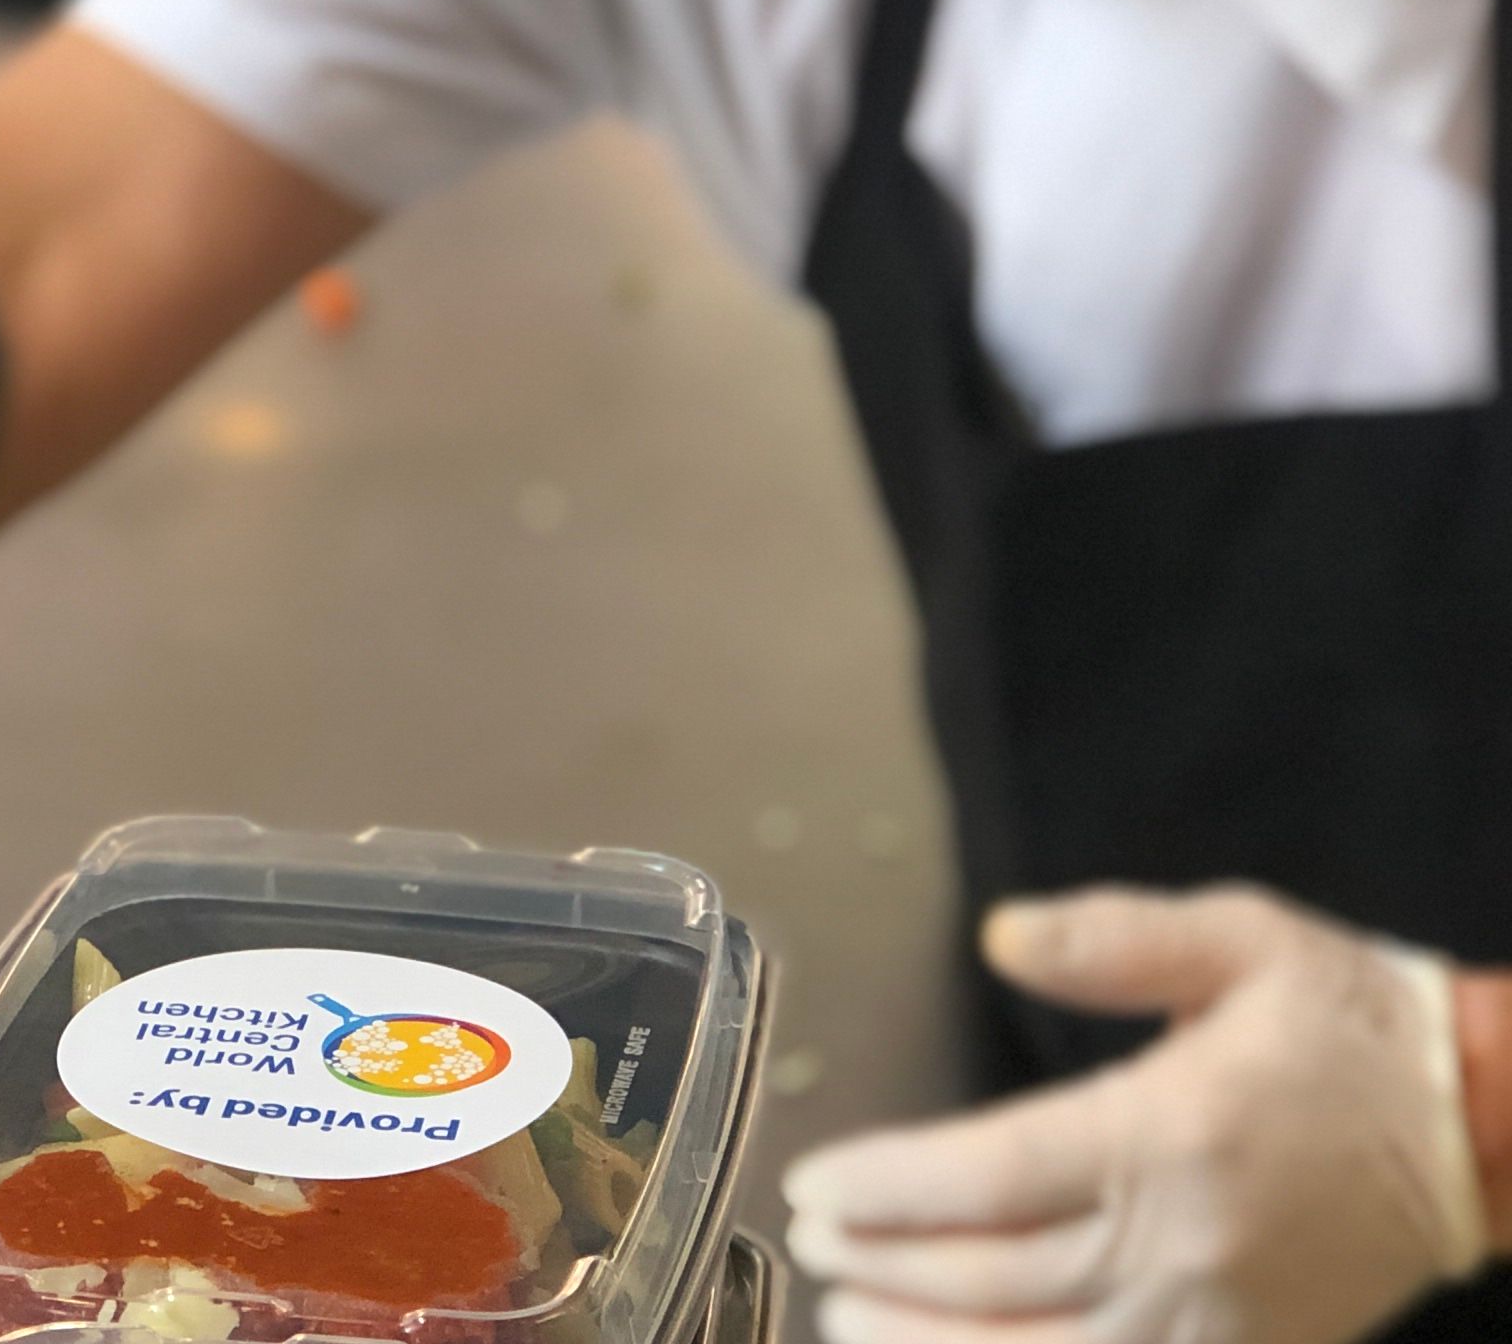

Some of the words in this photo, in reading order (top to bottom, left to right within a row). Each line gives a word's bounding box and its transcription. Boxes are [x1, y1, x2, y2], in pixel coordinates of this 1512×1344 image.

[137, 1000, 309, 1030] Kitchen
[136, 1021, 300, 1052] Central
[165, 1046, 295, 1074] World
[599, 1059, 639, 1125] MICROWAVE
[623, 1026, 651, 1056] SAFE
[129, 1088, 212, 1118] by:
[220, 1097, 461, 1142] Provided
